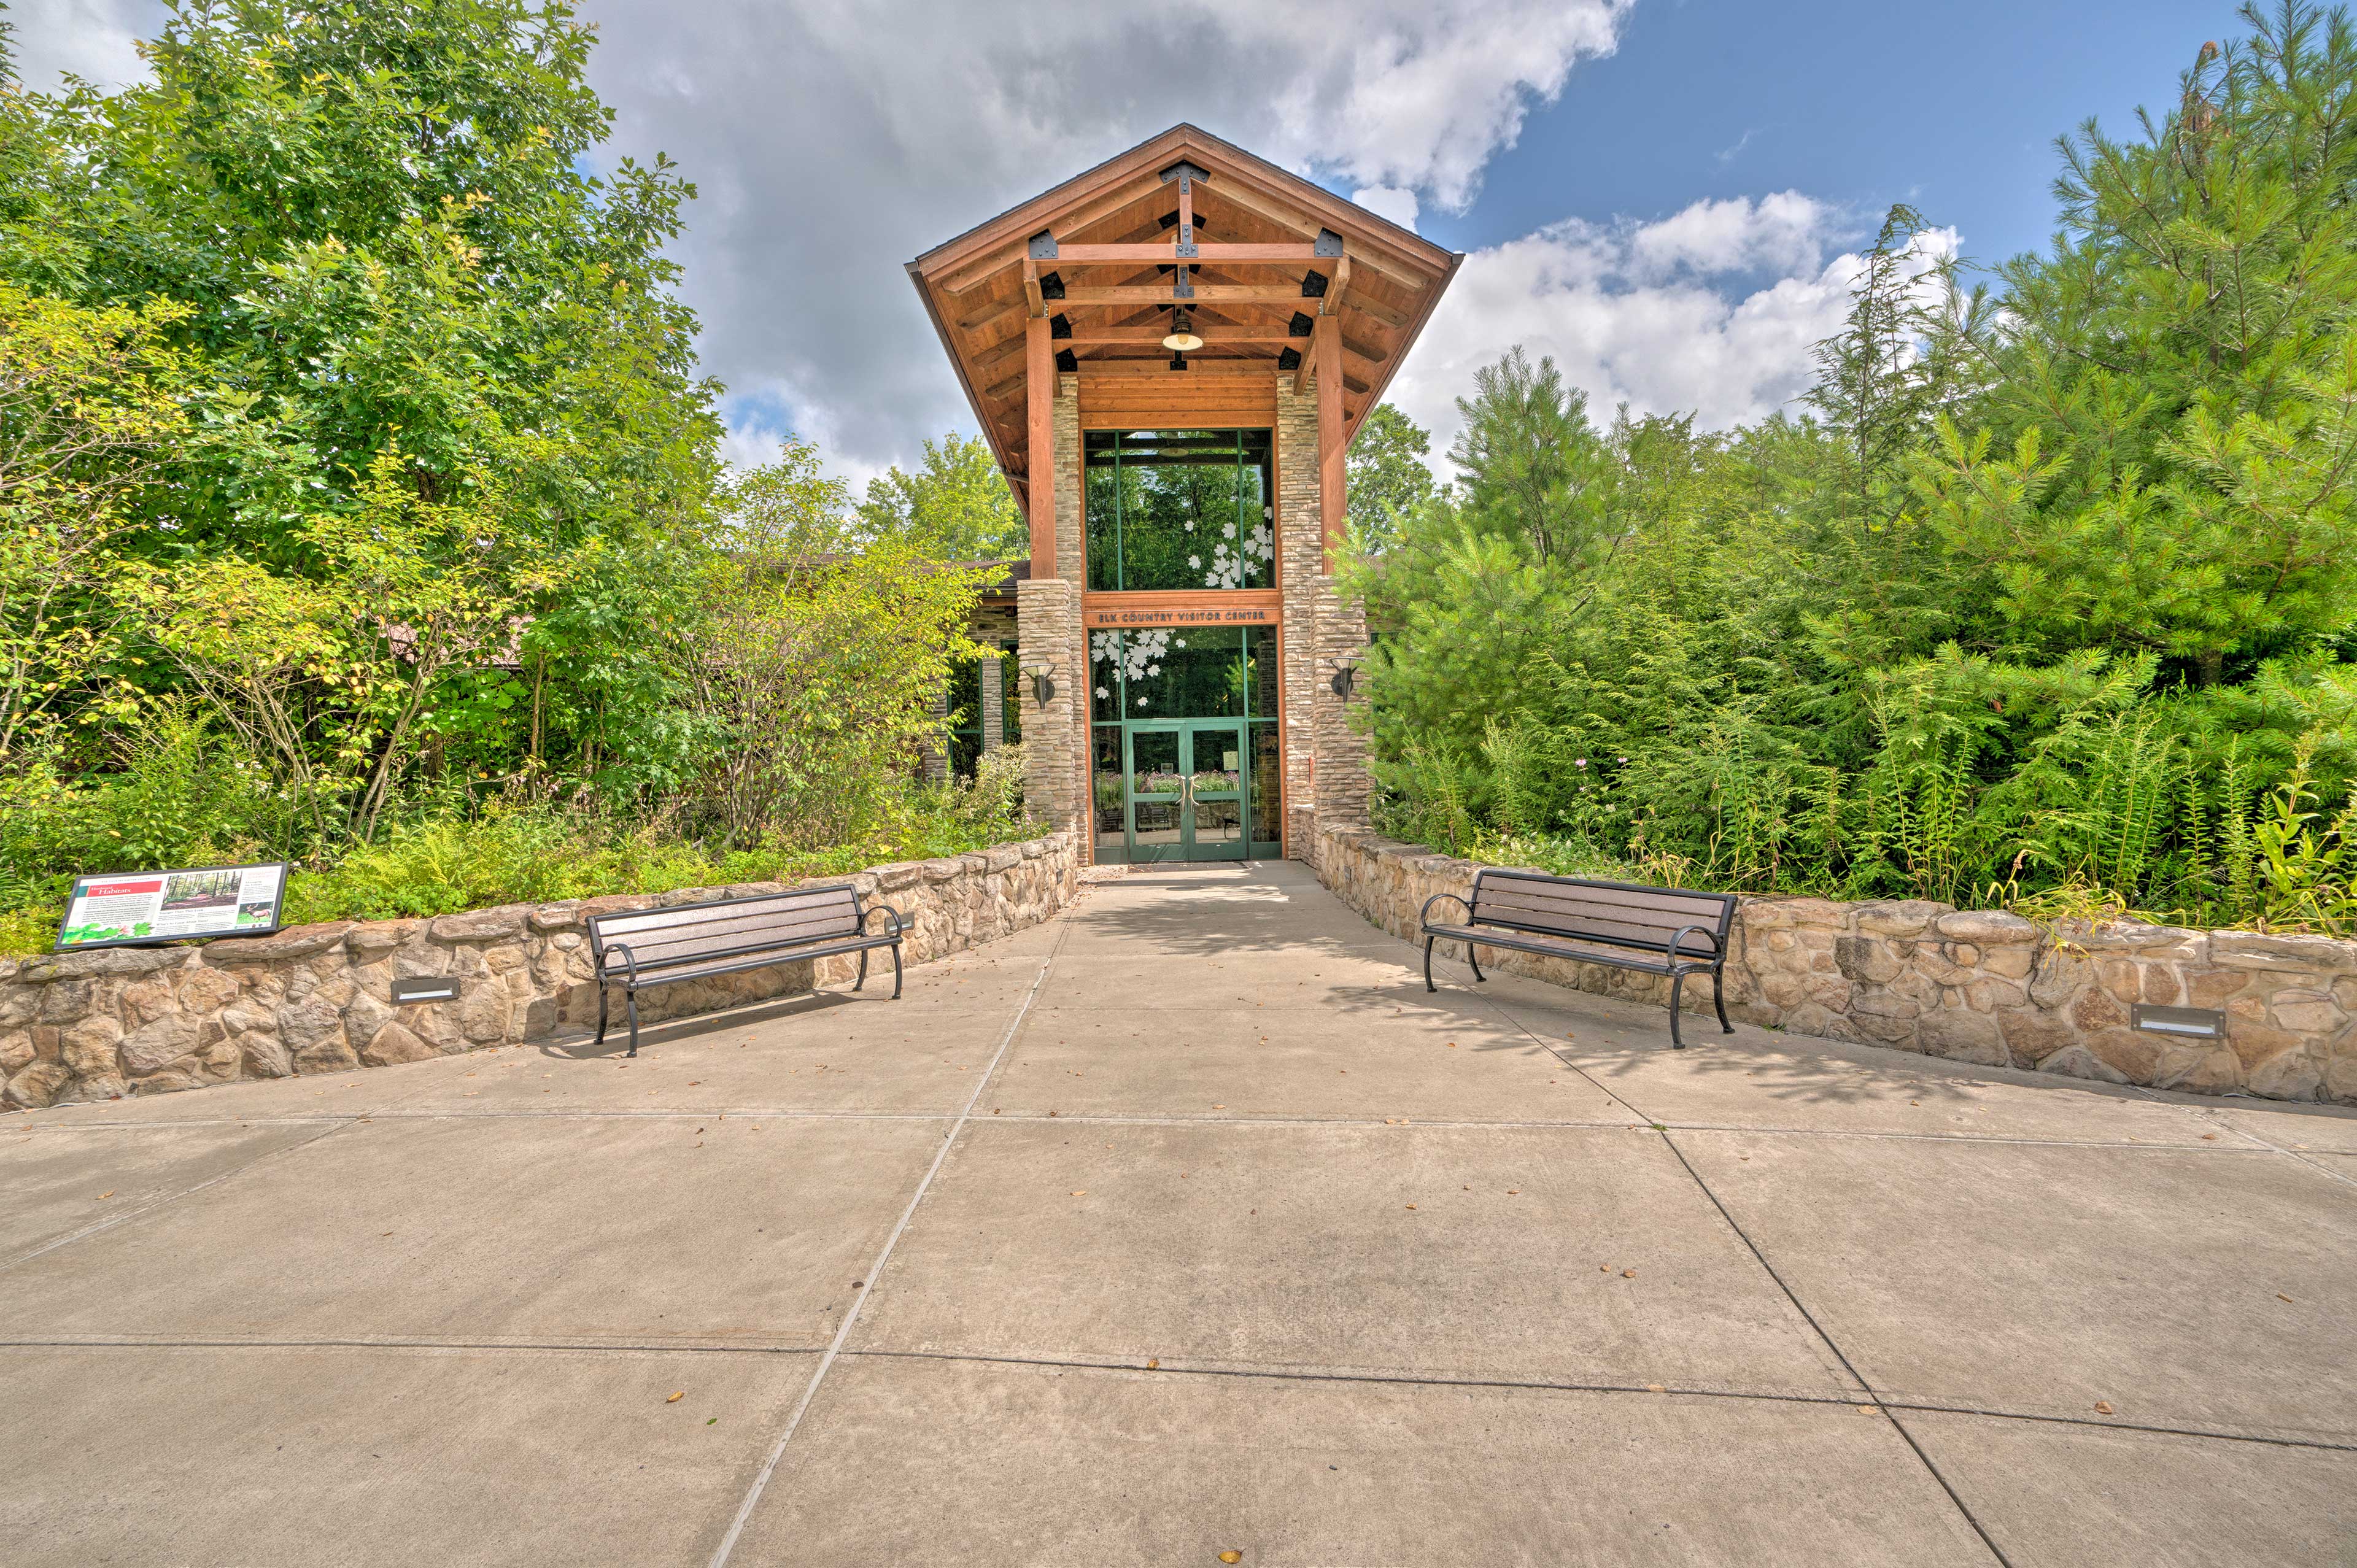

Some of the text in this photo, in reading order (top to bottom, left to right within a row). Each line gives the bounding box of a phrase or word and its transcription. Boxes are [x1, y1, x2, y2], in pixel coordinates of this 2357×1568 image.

[1099, 611, 1265, 623] ELK COUNTRY VISITOR CENTER
